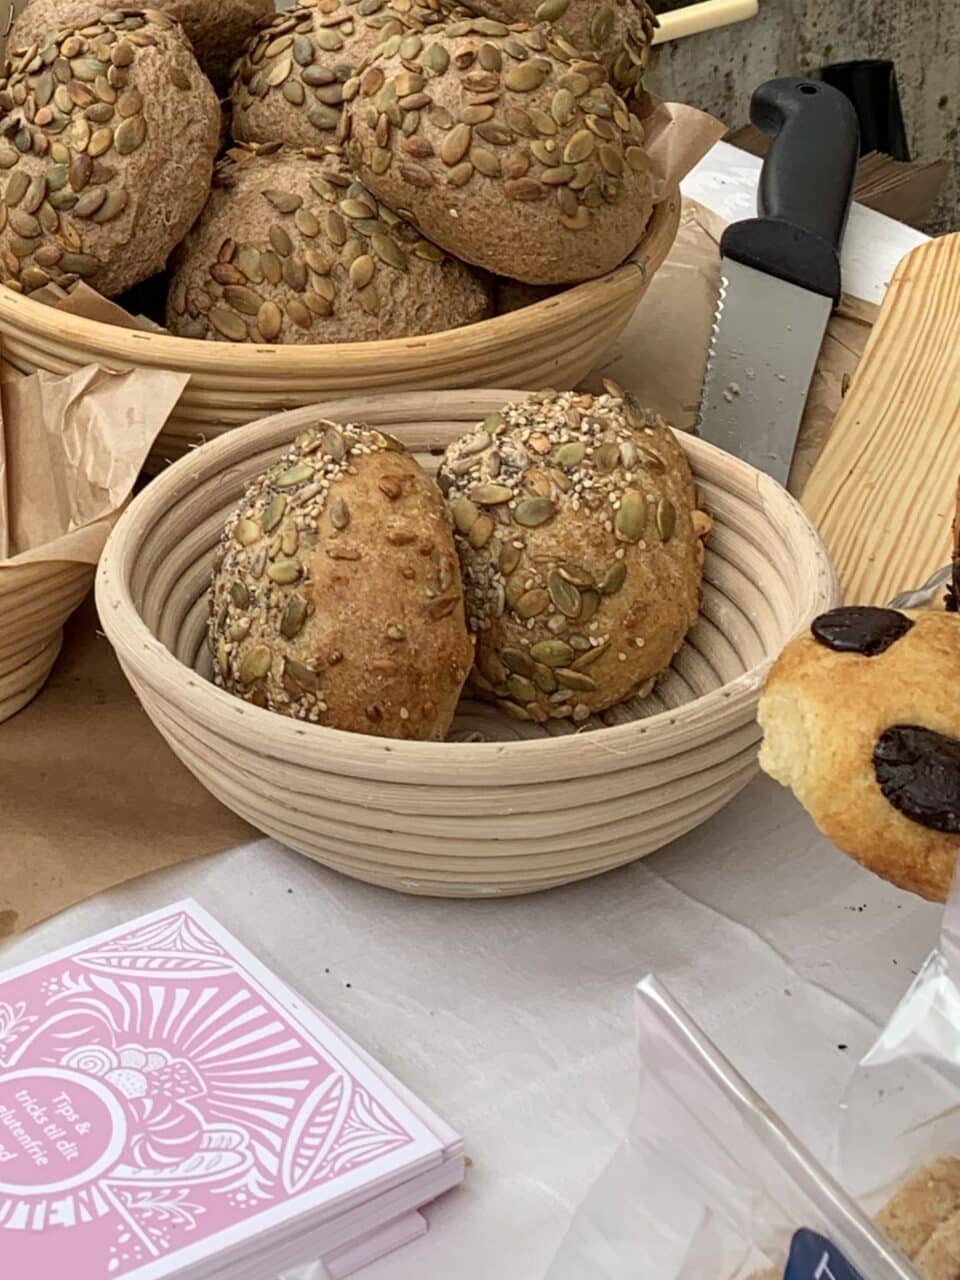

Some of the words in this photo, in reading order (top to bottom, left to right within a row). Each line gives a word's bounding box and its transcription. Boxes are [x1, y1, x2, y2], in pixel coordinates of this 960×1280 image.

[15, 1089, 49, 1125] tricks
[43, 1123, 67, 1141] til
[55, 1139, 80, 1162] dit
[51, 1091, 80, 1123] Tips
[74, 1121, 92, 1136] &
